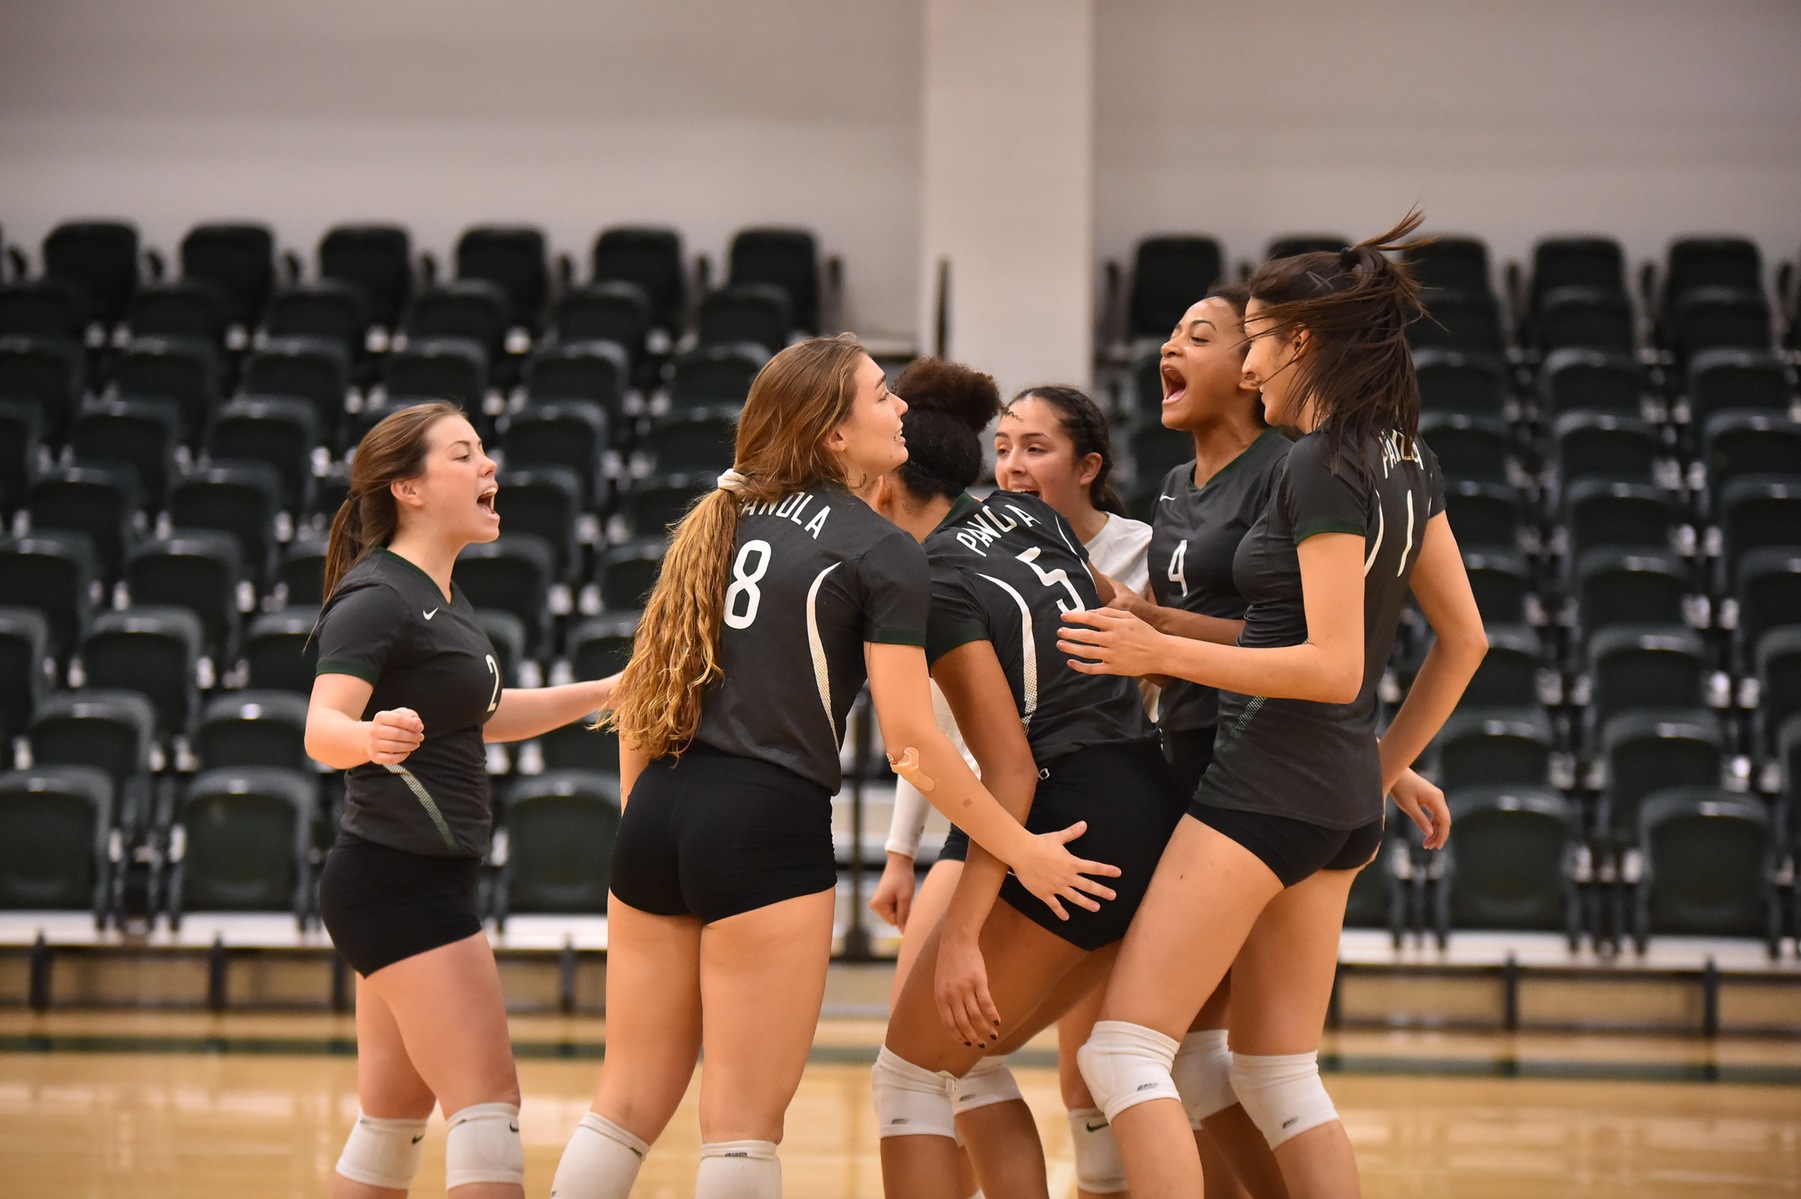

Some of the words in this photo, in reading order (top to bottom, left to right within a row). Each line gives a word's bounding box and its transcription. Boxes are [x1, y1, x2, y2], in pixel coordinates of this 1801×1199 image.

[738, 491, 832, 540] ANOLA
[1397, 489, 1414, 577] 1
[724, 539, 772, 629] 8
[1015, 546, 1086, 613] 5
[1168, 539, 1188, 598] 4
[486, 654, 499, 712] 2
